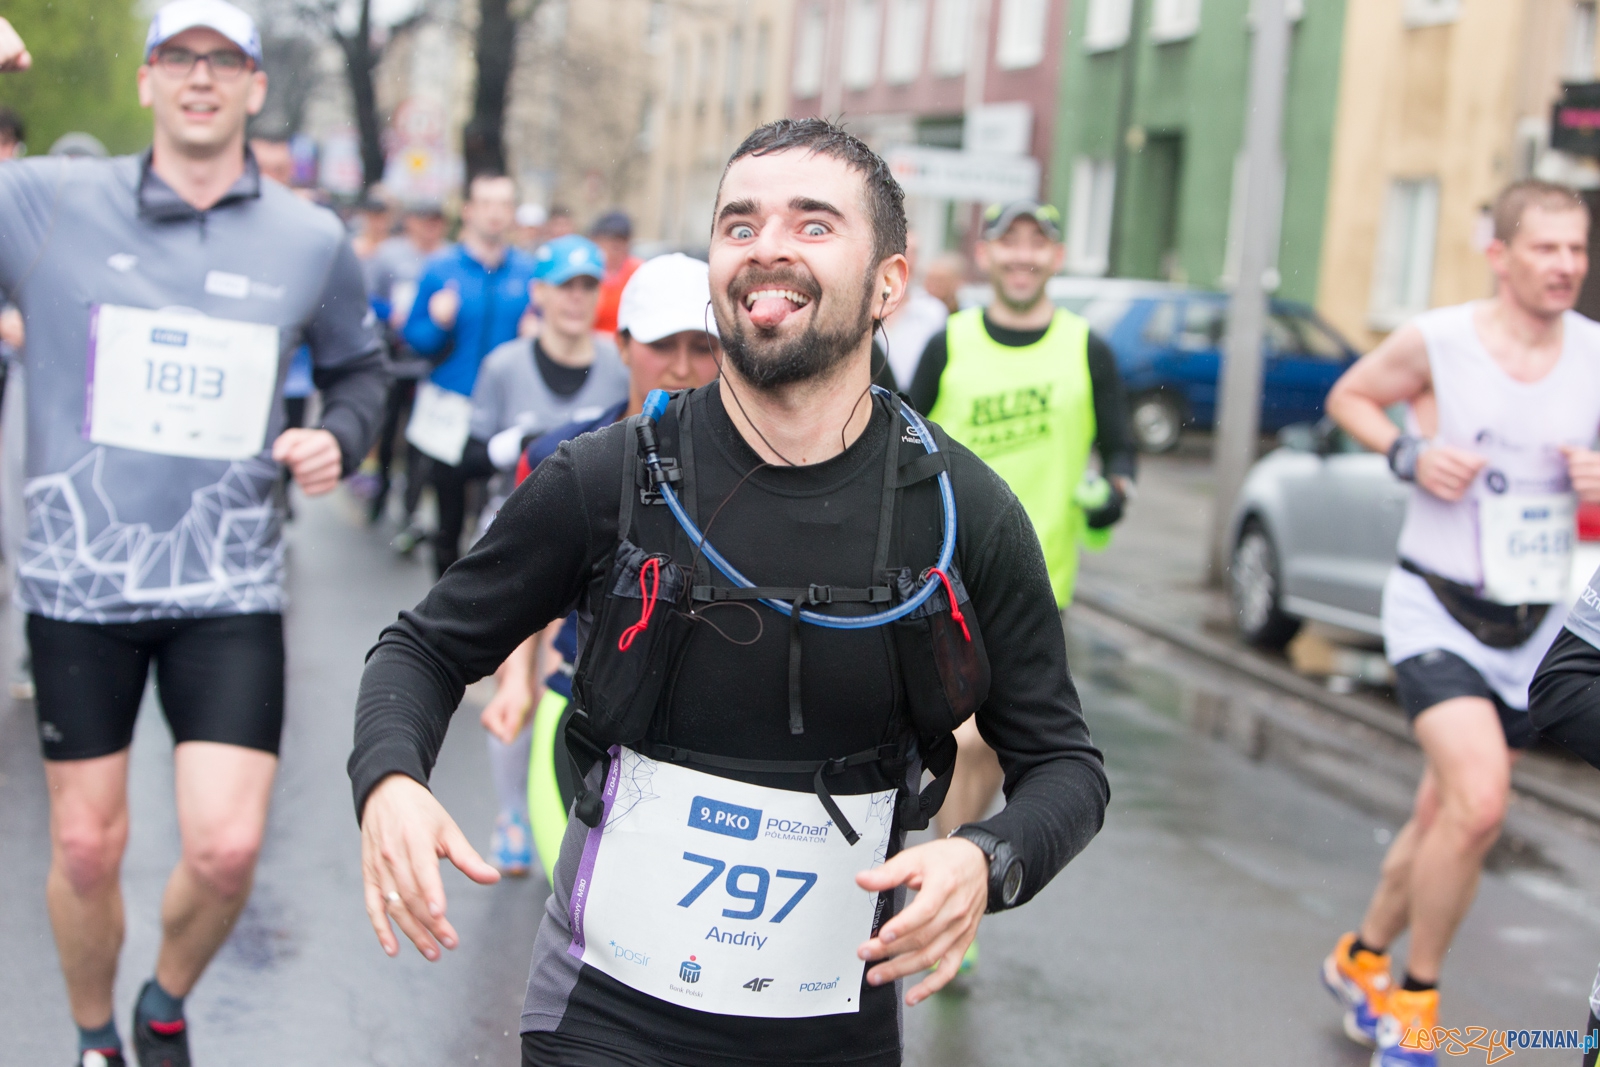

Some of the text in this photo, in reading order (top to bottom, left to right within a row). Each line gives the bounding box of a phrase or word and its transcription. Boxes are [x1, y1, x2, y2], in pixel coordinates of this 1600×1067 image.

[144, 360, 225, 400] 1813
[902, 436, 922, 444] Kale
[700, 807, 712, 823] 9.
[715, 811, 750, 830] PKO
[764, 831, 827, 843] PÓŁMARATON
[577, 878, 586, 898] M30
[676, 851, 818, 924] 797
[705, 926, 768, 951] Andriy
[669, 983, 704, 998] Bank Polski
[742, 977, 774, 993] 4F
